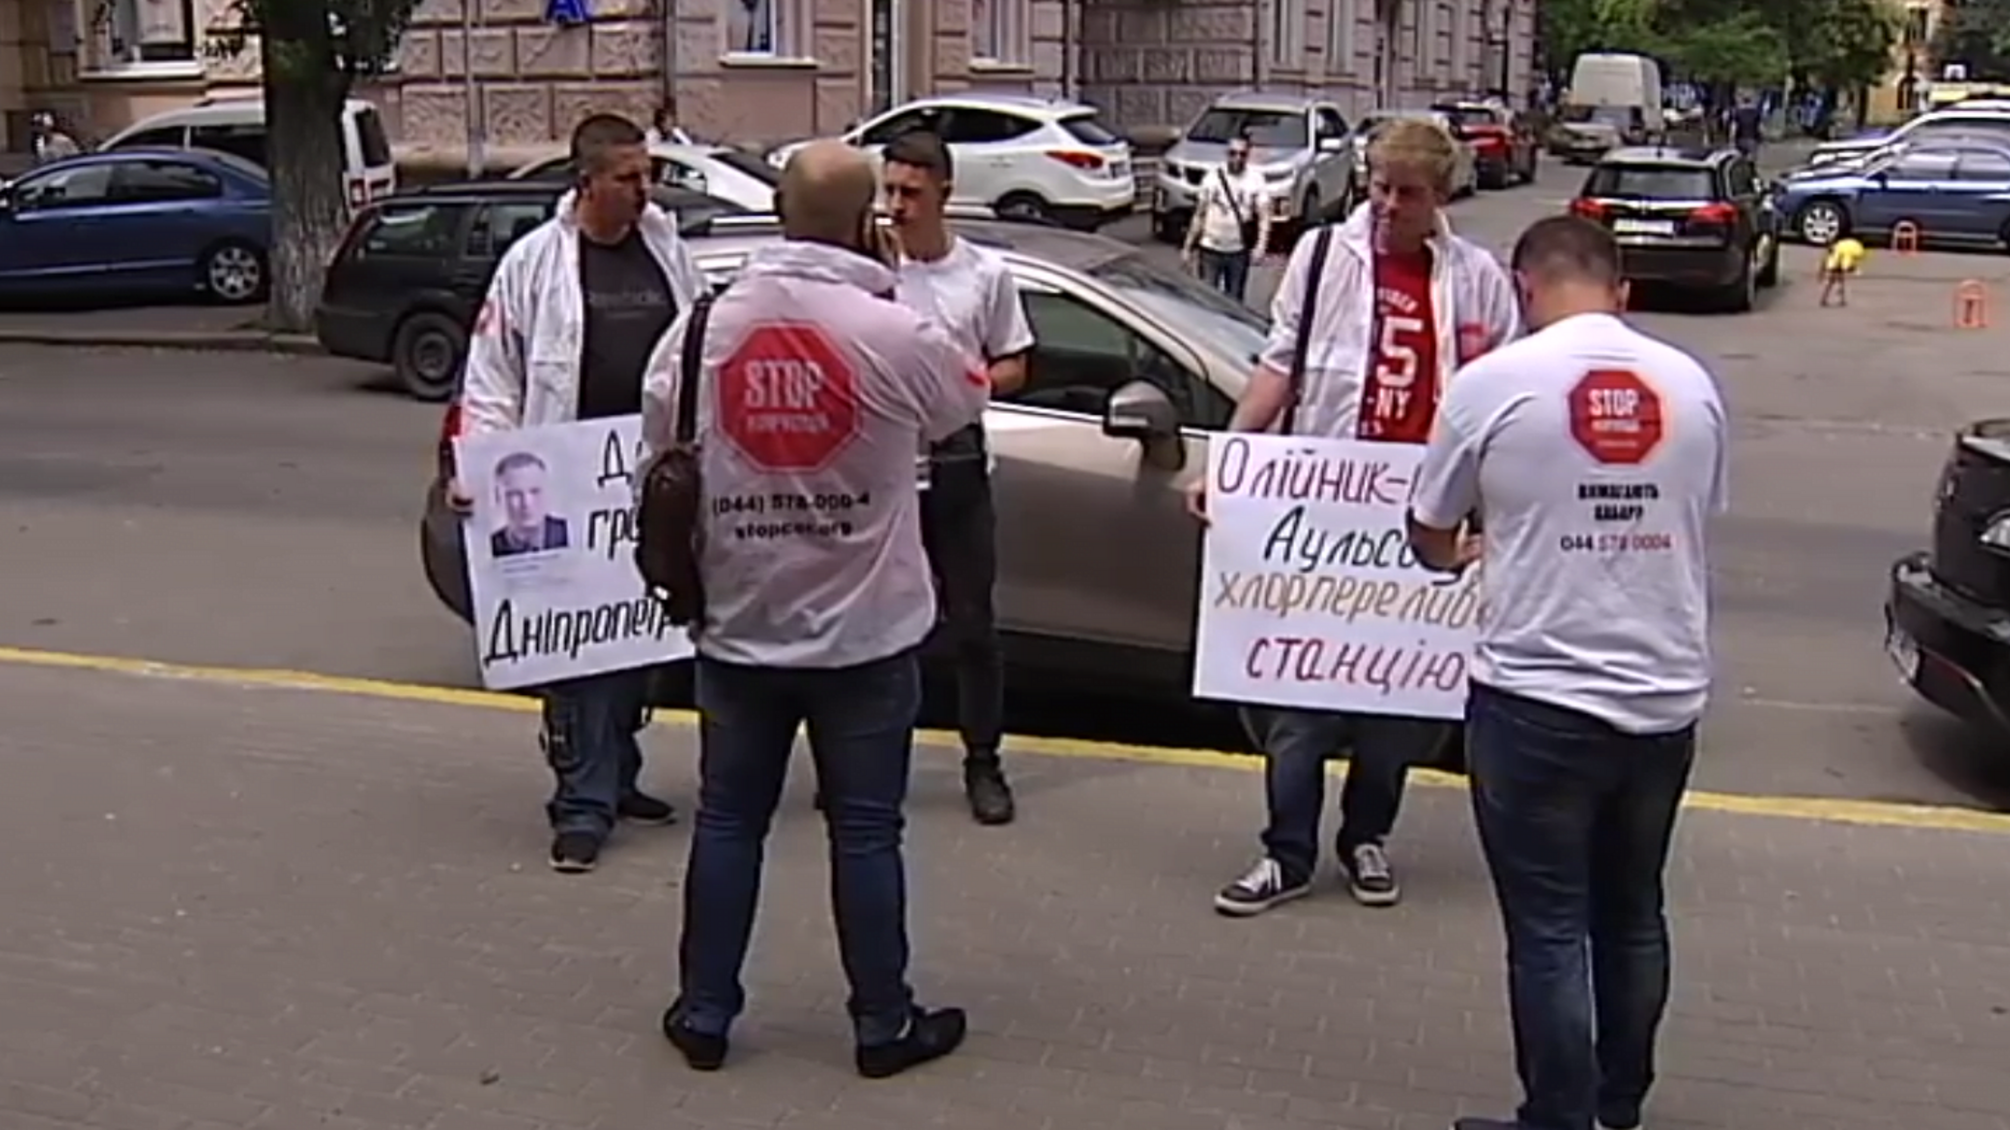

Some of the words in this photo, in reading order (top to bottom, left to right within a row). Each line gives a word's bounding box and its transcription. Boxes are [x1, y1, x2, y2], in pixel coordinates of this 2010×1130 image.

[744, 359, 824, 409] STOP
[1588, 387, 1640, 417] STOP
[1217, 437, 1422, 506] Олійник-
[713, 493, 765, 517] (044)
[1559, 533, 1594, 551] 044
[1245, 636, 1466, 695] станцію
